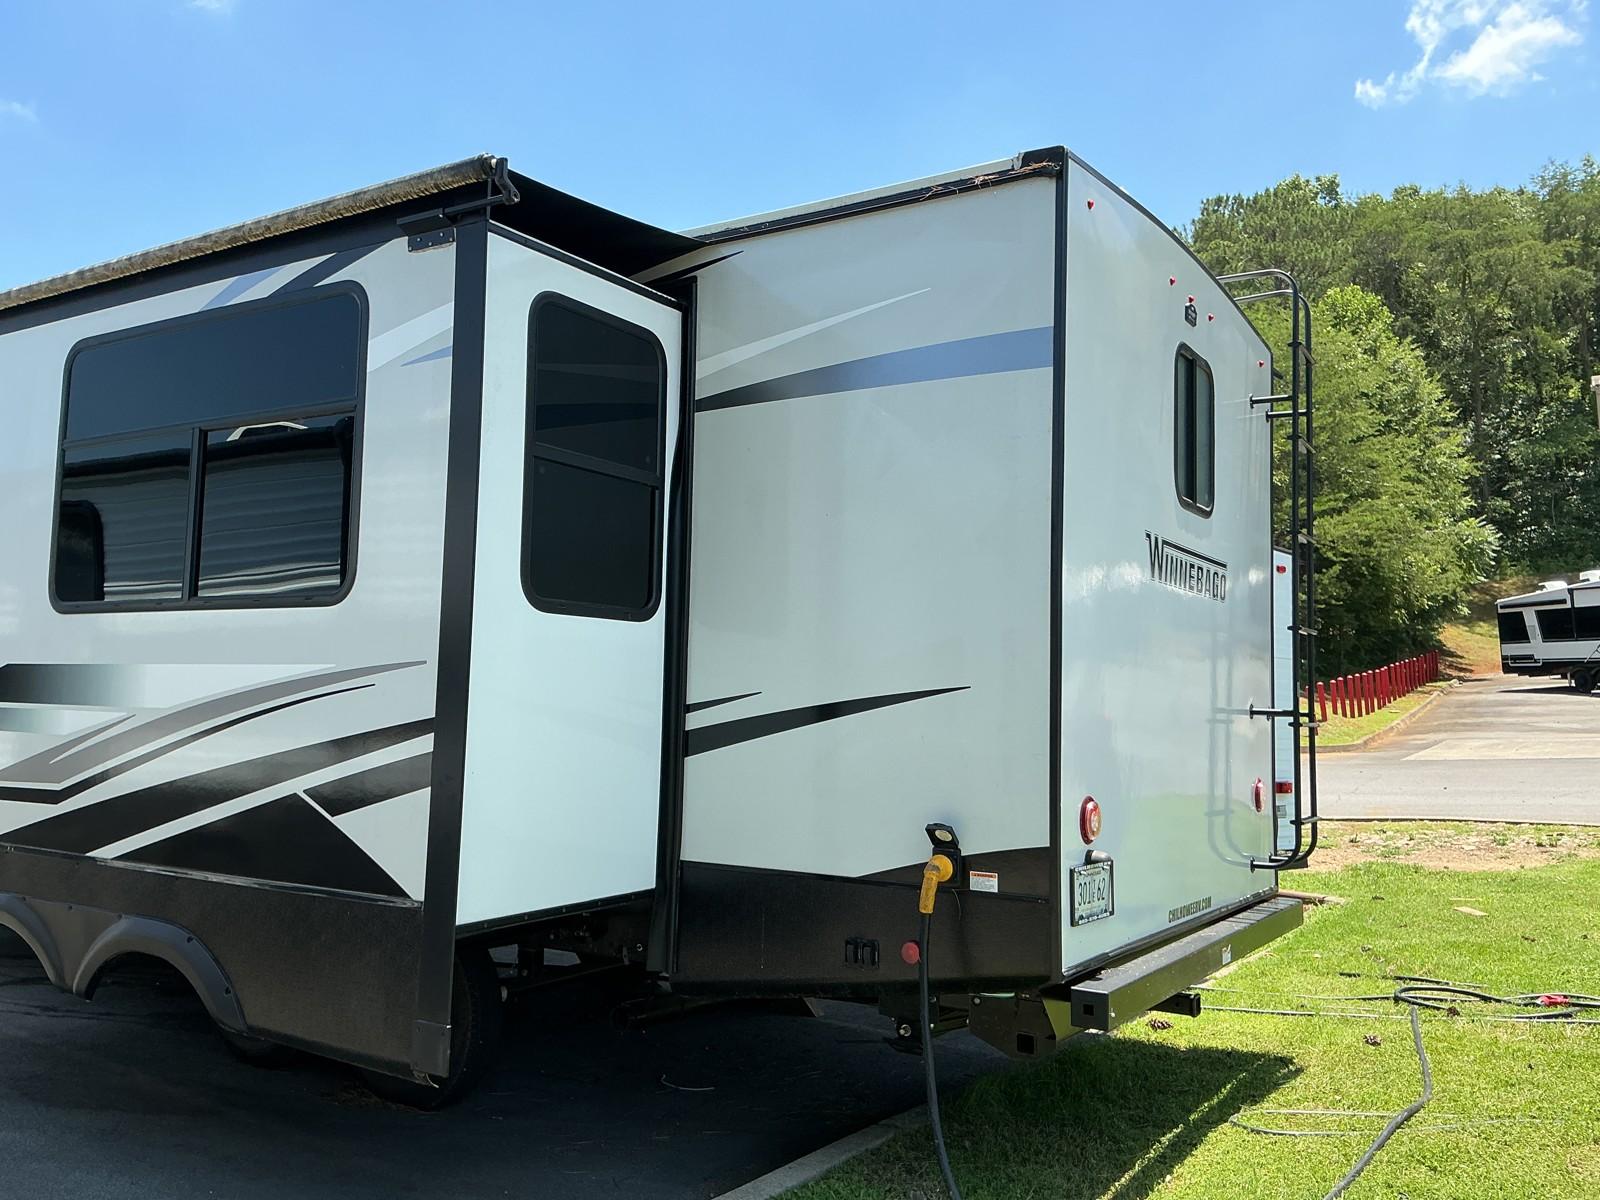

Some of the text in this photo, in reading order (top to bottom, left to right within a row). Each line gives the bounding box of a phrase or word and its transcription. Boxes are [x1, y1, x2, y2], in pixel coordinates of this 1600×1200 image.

[1145, 530, 1228, 602] WINNEBAGO
[1078, 880, 1091, 906] 301
[1097, 877, 1106, 902] 62
